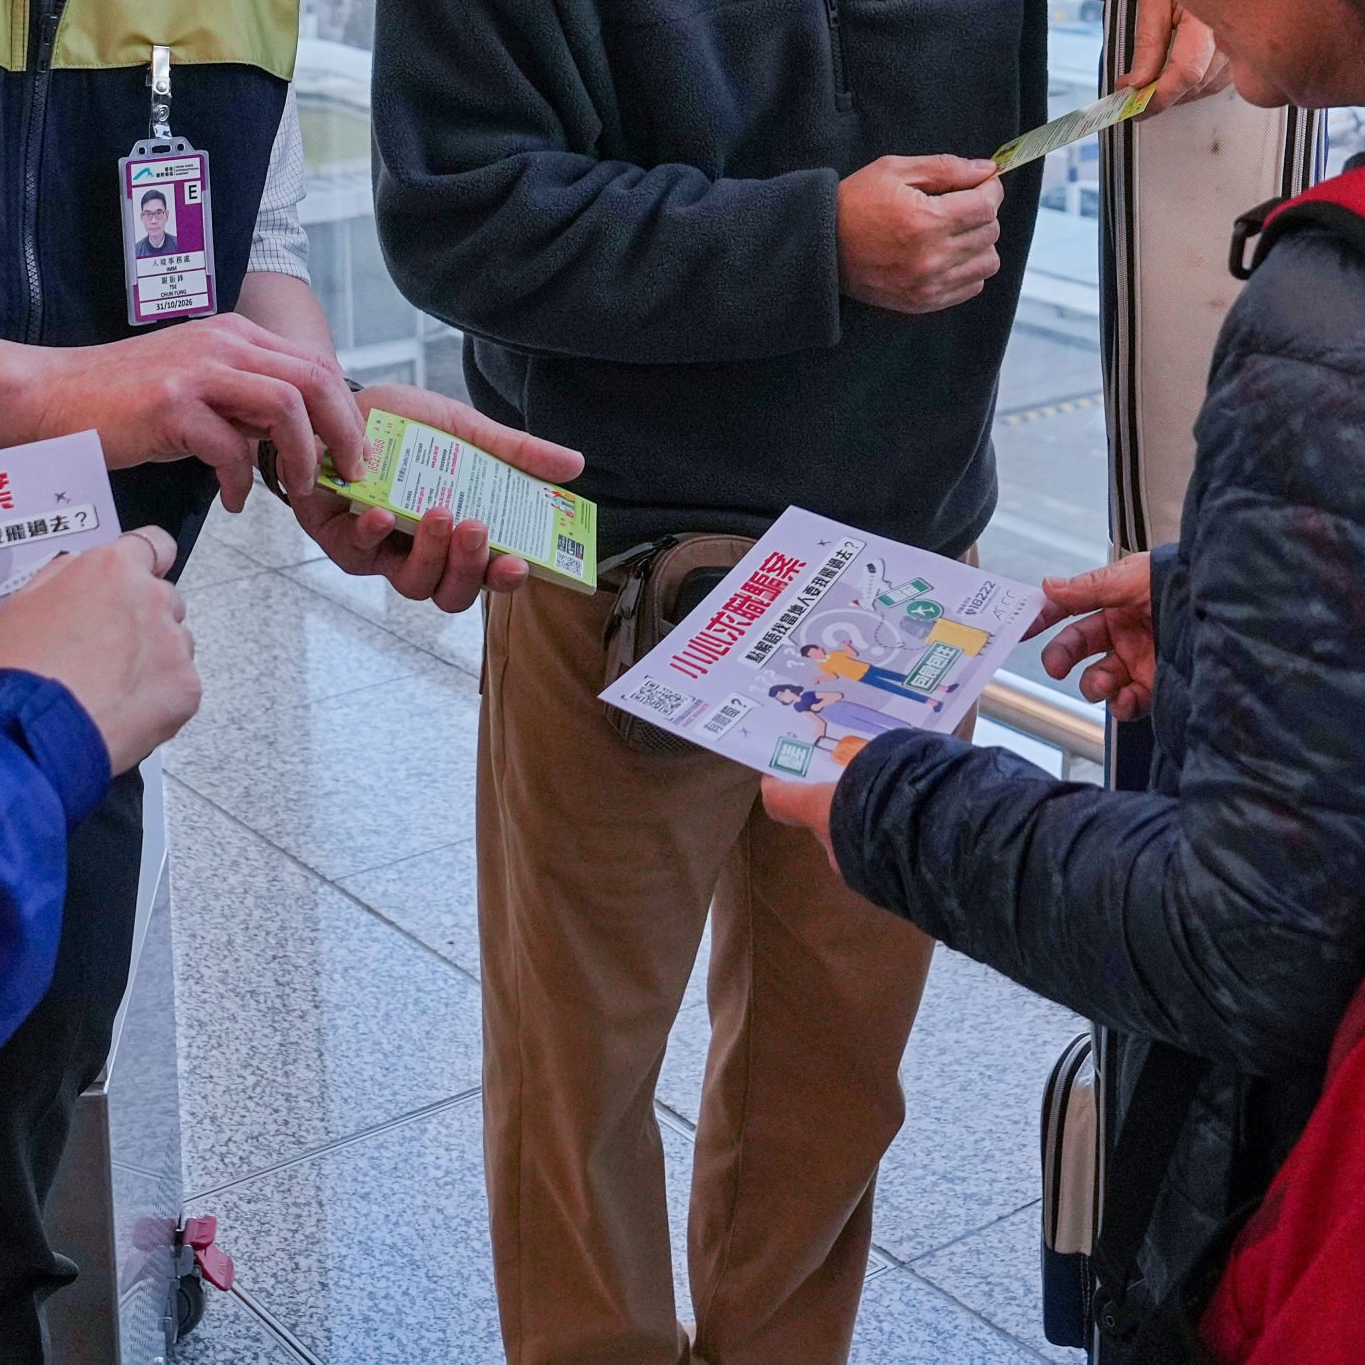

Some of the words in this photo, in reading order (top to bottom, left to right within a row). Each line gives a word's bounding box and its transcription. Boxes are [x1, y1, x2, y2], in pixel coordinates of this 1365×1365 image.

[188, 184, 198, 200] E
[156, 298, 193, 311] 31/10/2026
[669, 551, 807, 679] 小心求職騙案
